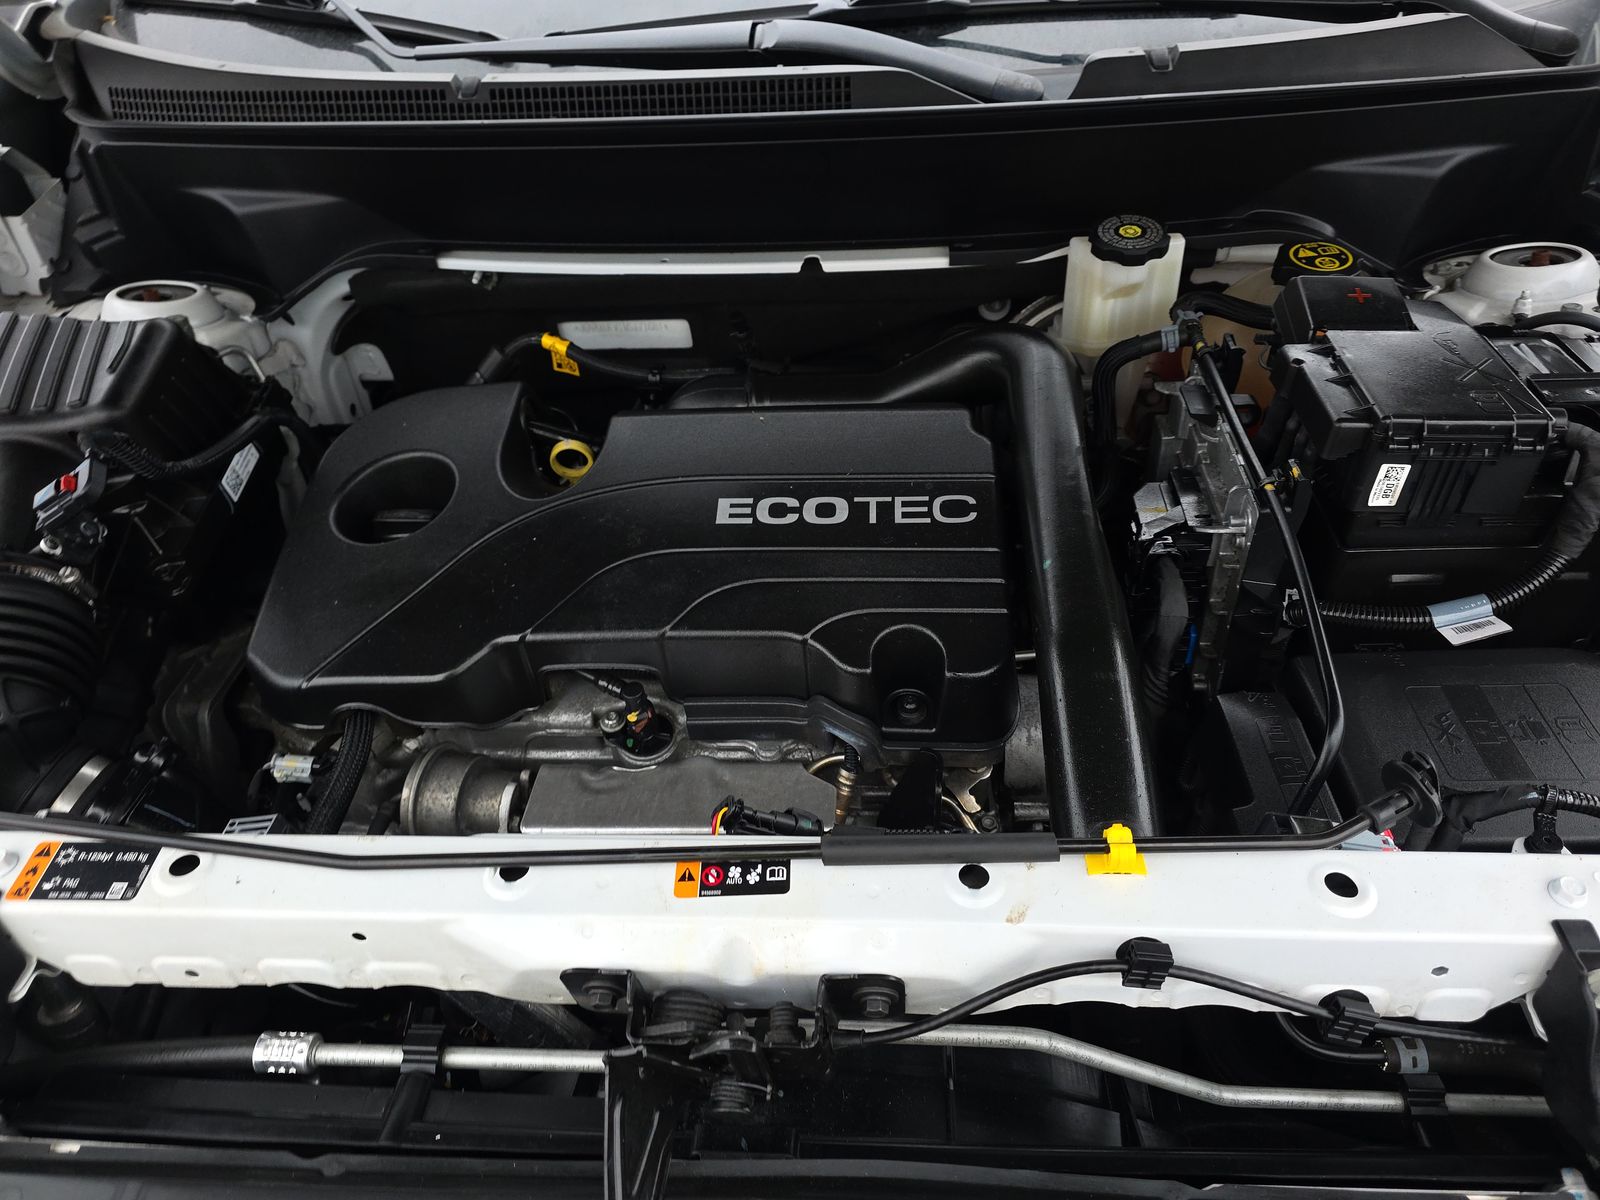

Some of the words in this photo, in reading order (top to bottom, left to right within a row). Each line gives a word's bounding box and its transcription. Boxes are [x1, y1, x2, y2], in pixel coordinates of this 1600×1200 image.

[1382, 484, 1395, 499] DGB
[715, 494, 978, 525] ECOTEC
[137, 852, 149, 863] kg
